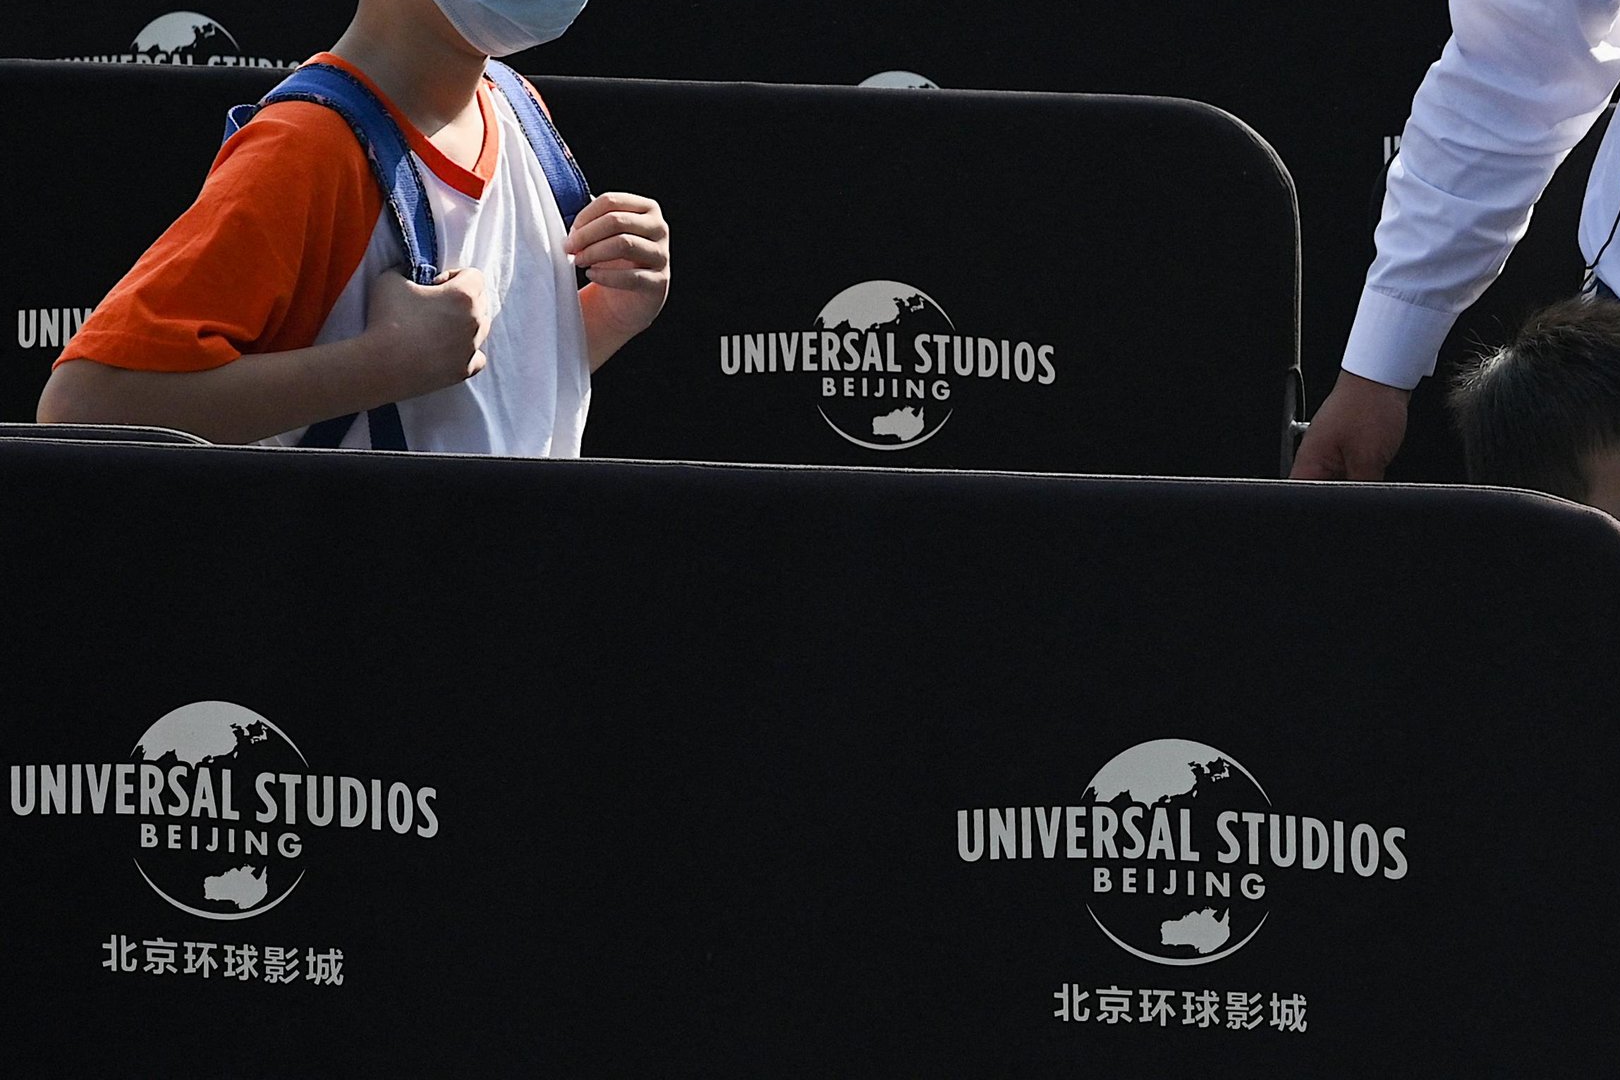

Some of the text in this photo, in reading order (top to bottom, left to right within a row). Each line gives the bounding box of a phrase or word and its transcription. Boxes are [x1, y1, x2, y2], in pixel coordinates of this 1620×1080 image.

[17, 307, 93, 349] UNIV
[720, 331, 1056, 385] UNIVERSAL STUDIOS
[822, 377, 951, 401] BEIJING
[10, 763, 439, 839] UNIVERSAL STUDIOS
[140, 823, 303, 859] BEIJING
[957, 806, 1408, 880] UNIVERSAL STUDIOS
[1093, 867, 1266, 900] BEIJING
[101, 934, 345, 986] 北京环球影城
[1053, 983, 1308, 1033] 北京环球影城
